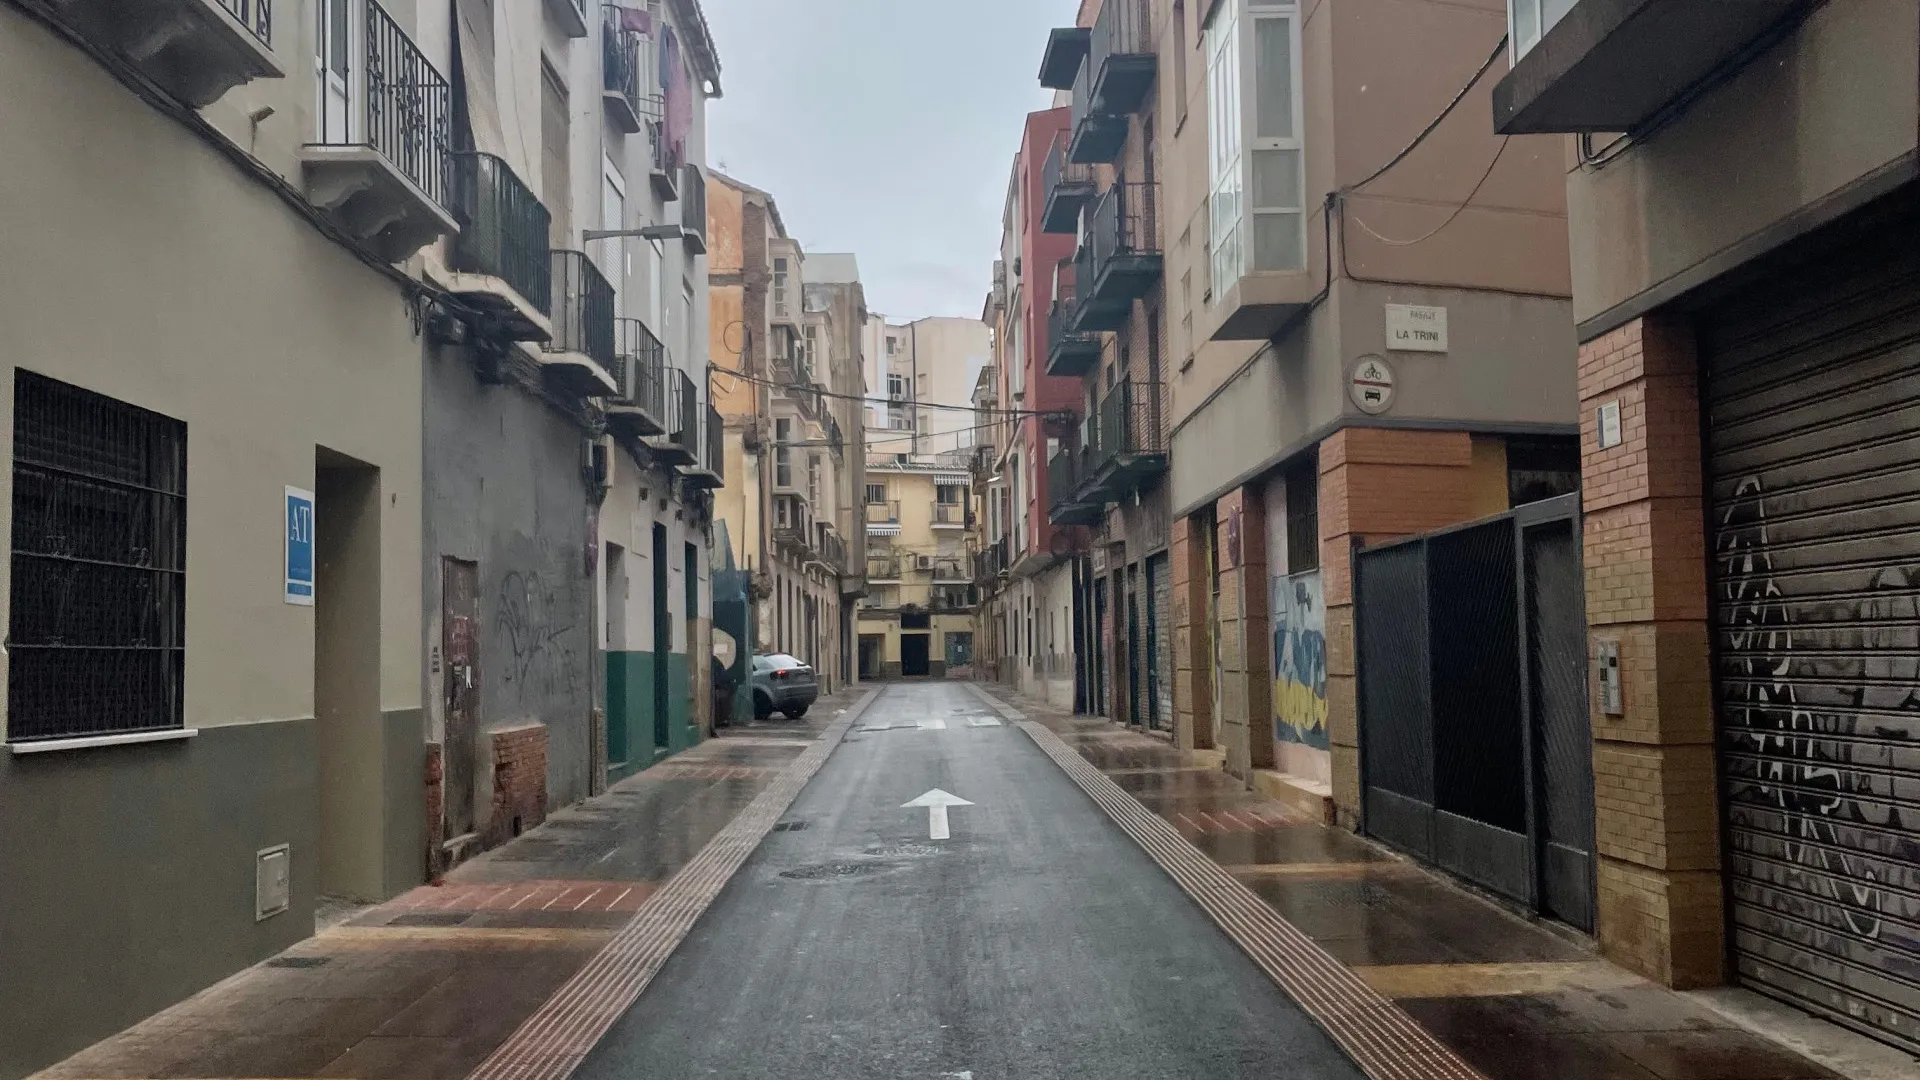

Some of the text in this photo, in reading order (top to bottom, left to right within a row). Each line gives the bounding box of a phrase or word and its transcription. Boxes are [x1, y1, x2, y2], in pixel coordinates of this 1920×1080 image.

[1396, 330, 1439, 341] LA TRINI
[290, 504, 310, 543] AT
